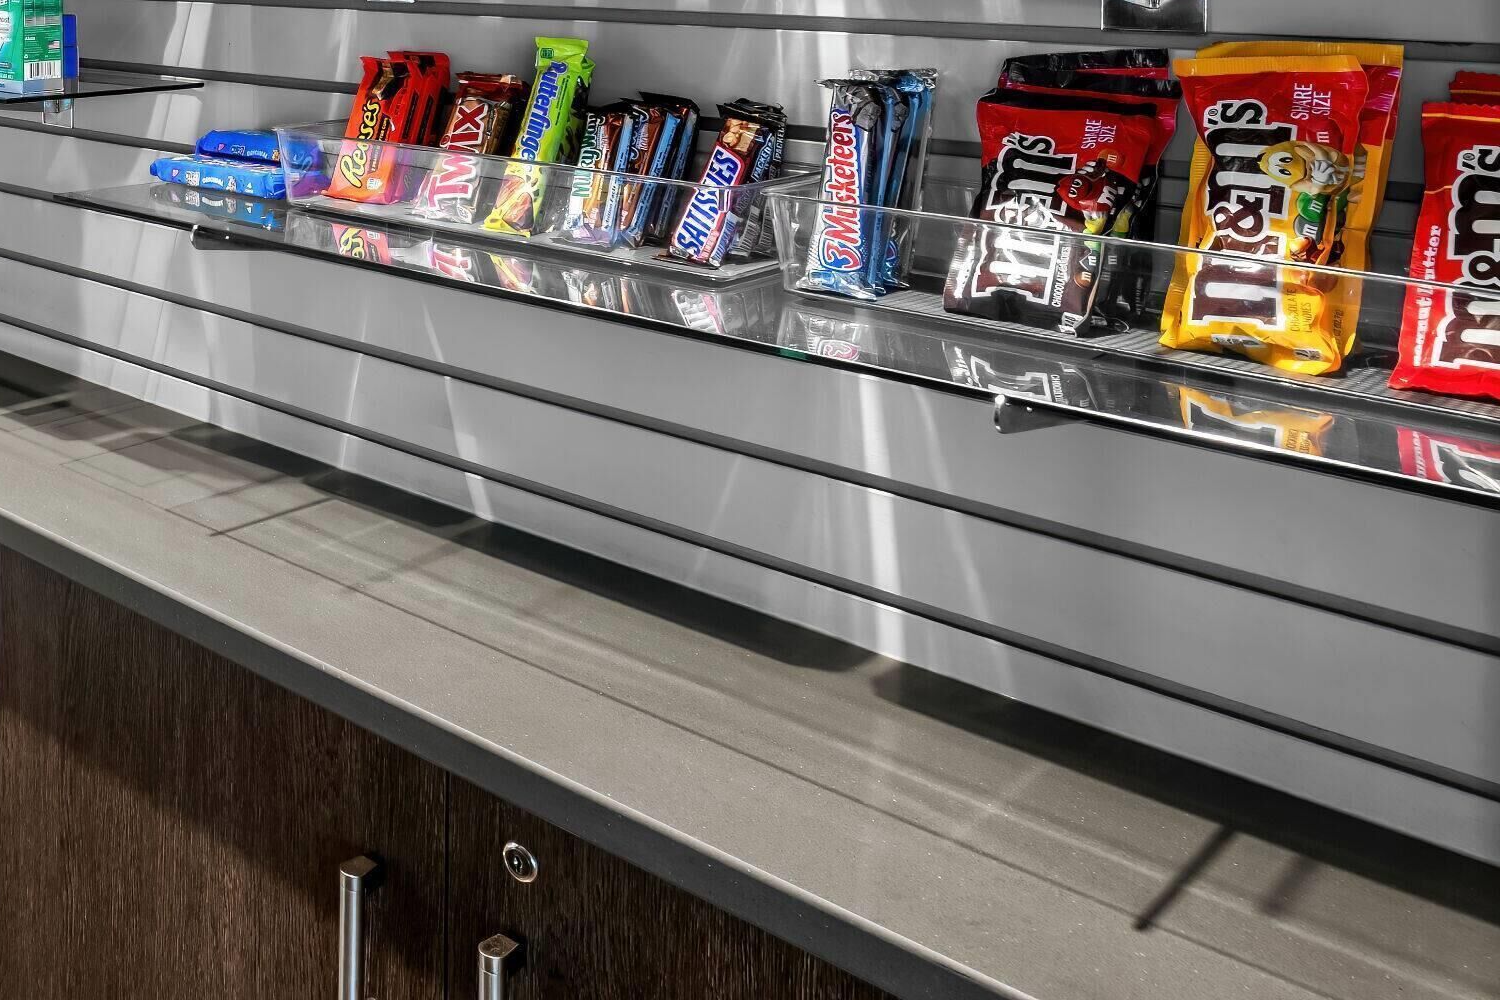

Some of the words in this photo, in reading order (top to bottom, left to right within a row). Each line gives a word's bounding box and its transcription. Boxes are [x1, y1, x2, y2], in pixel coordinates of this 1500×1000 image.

[1290, 82, 1313, 121] SHARE
[1312, 90, 1332, 117] SIZE
[1080, 118, 1102, 149] SHARE
[1098, 124, 1117, 143] SIZE
[824, 109, 862, 249] Musketeers
[820, 243, 862, 272] 3
[1286, 288, 1301, 333] CHOCOLATE
